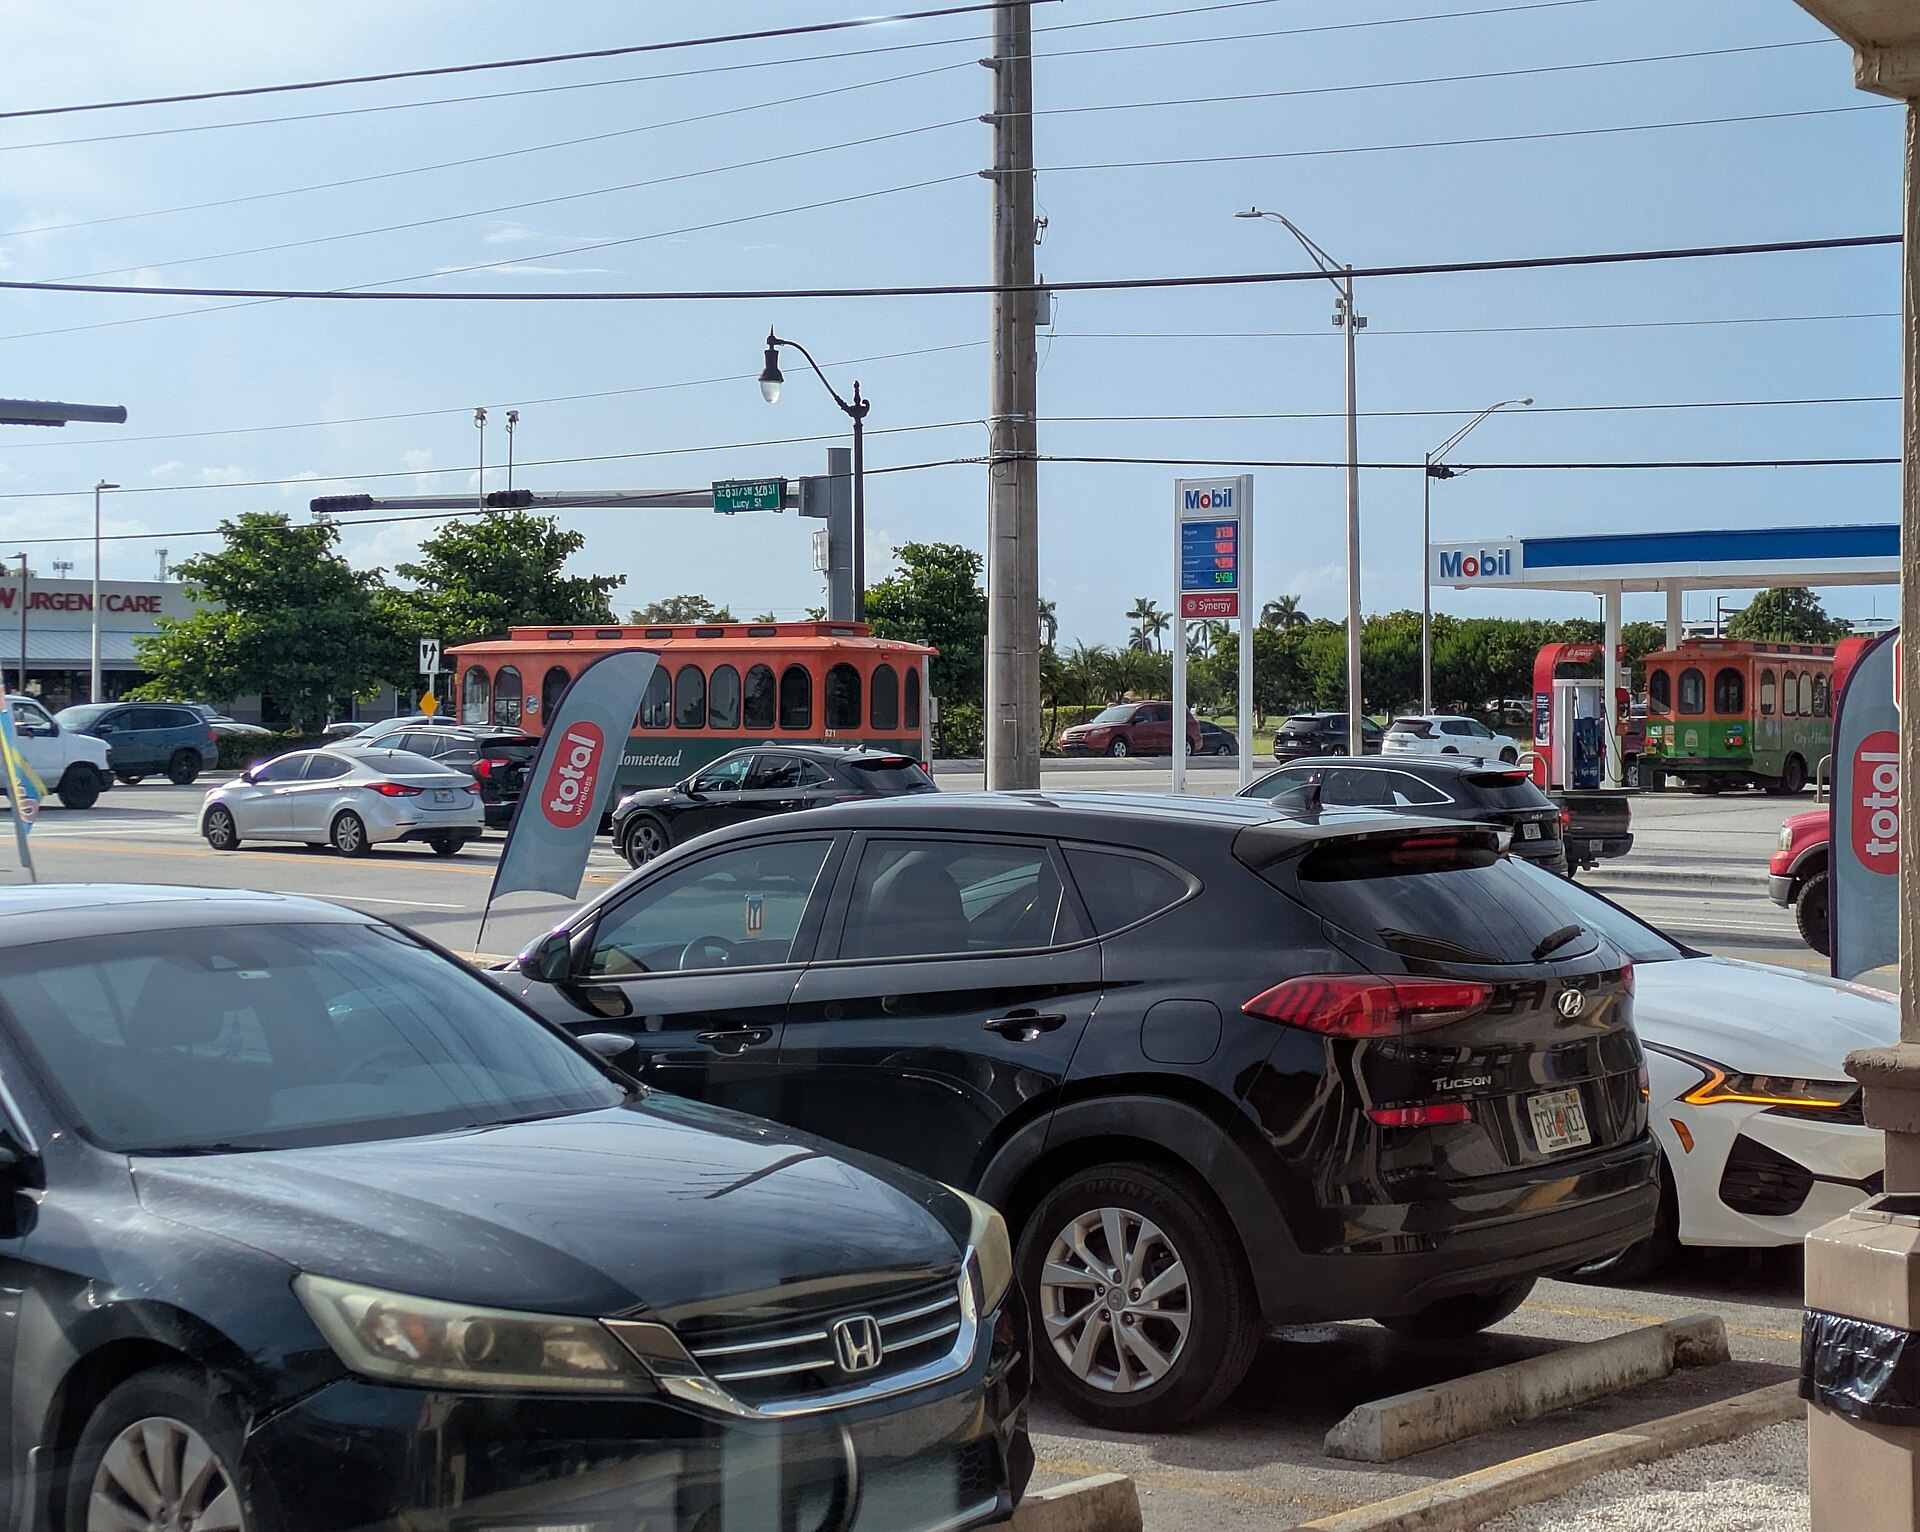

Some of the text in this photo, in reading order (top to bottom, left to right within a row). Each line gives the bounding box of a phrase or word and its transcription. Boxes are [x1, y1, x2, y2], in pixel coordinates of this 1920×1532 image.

[732, 497, 762, 510] Lucy St
[1184, 487, 1232, 510] Mobil
[1440, 548, 1512, 578] Mobil
[106, 595, 162, 613] CARE
[1198, 600, 1231, 613] Synergy
[825, 728, 836, 738] 621
[550, 733, 596, 813] total
[575, 776, 593, 816] wireless
[1861, 752, 1899, 856] total
[1432, 1075, 1492, 1091] TUCSON
